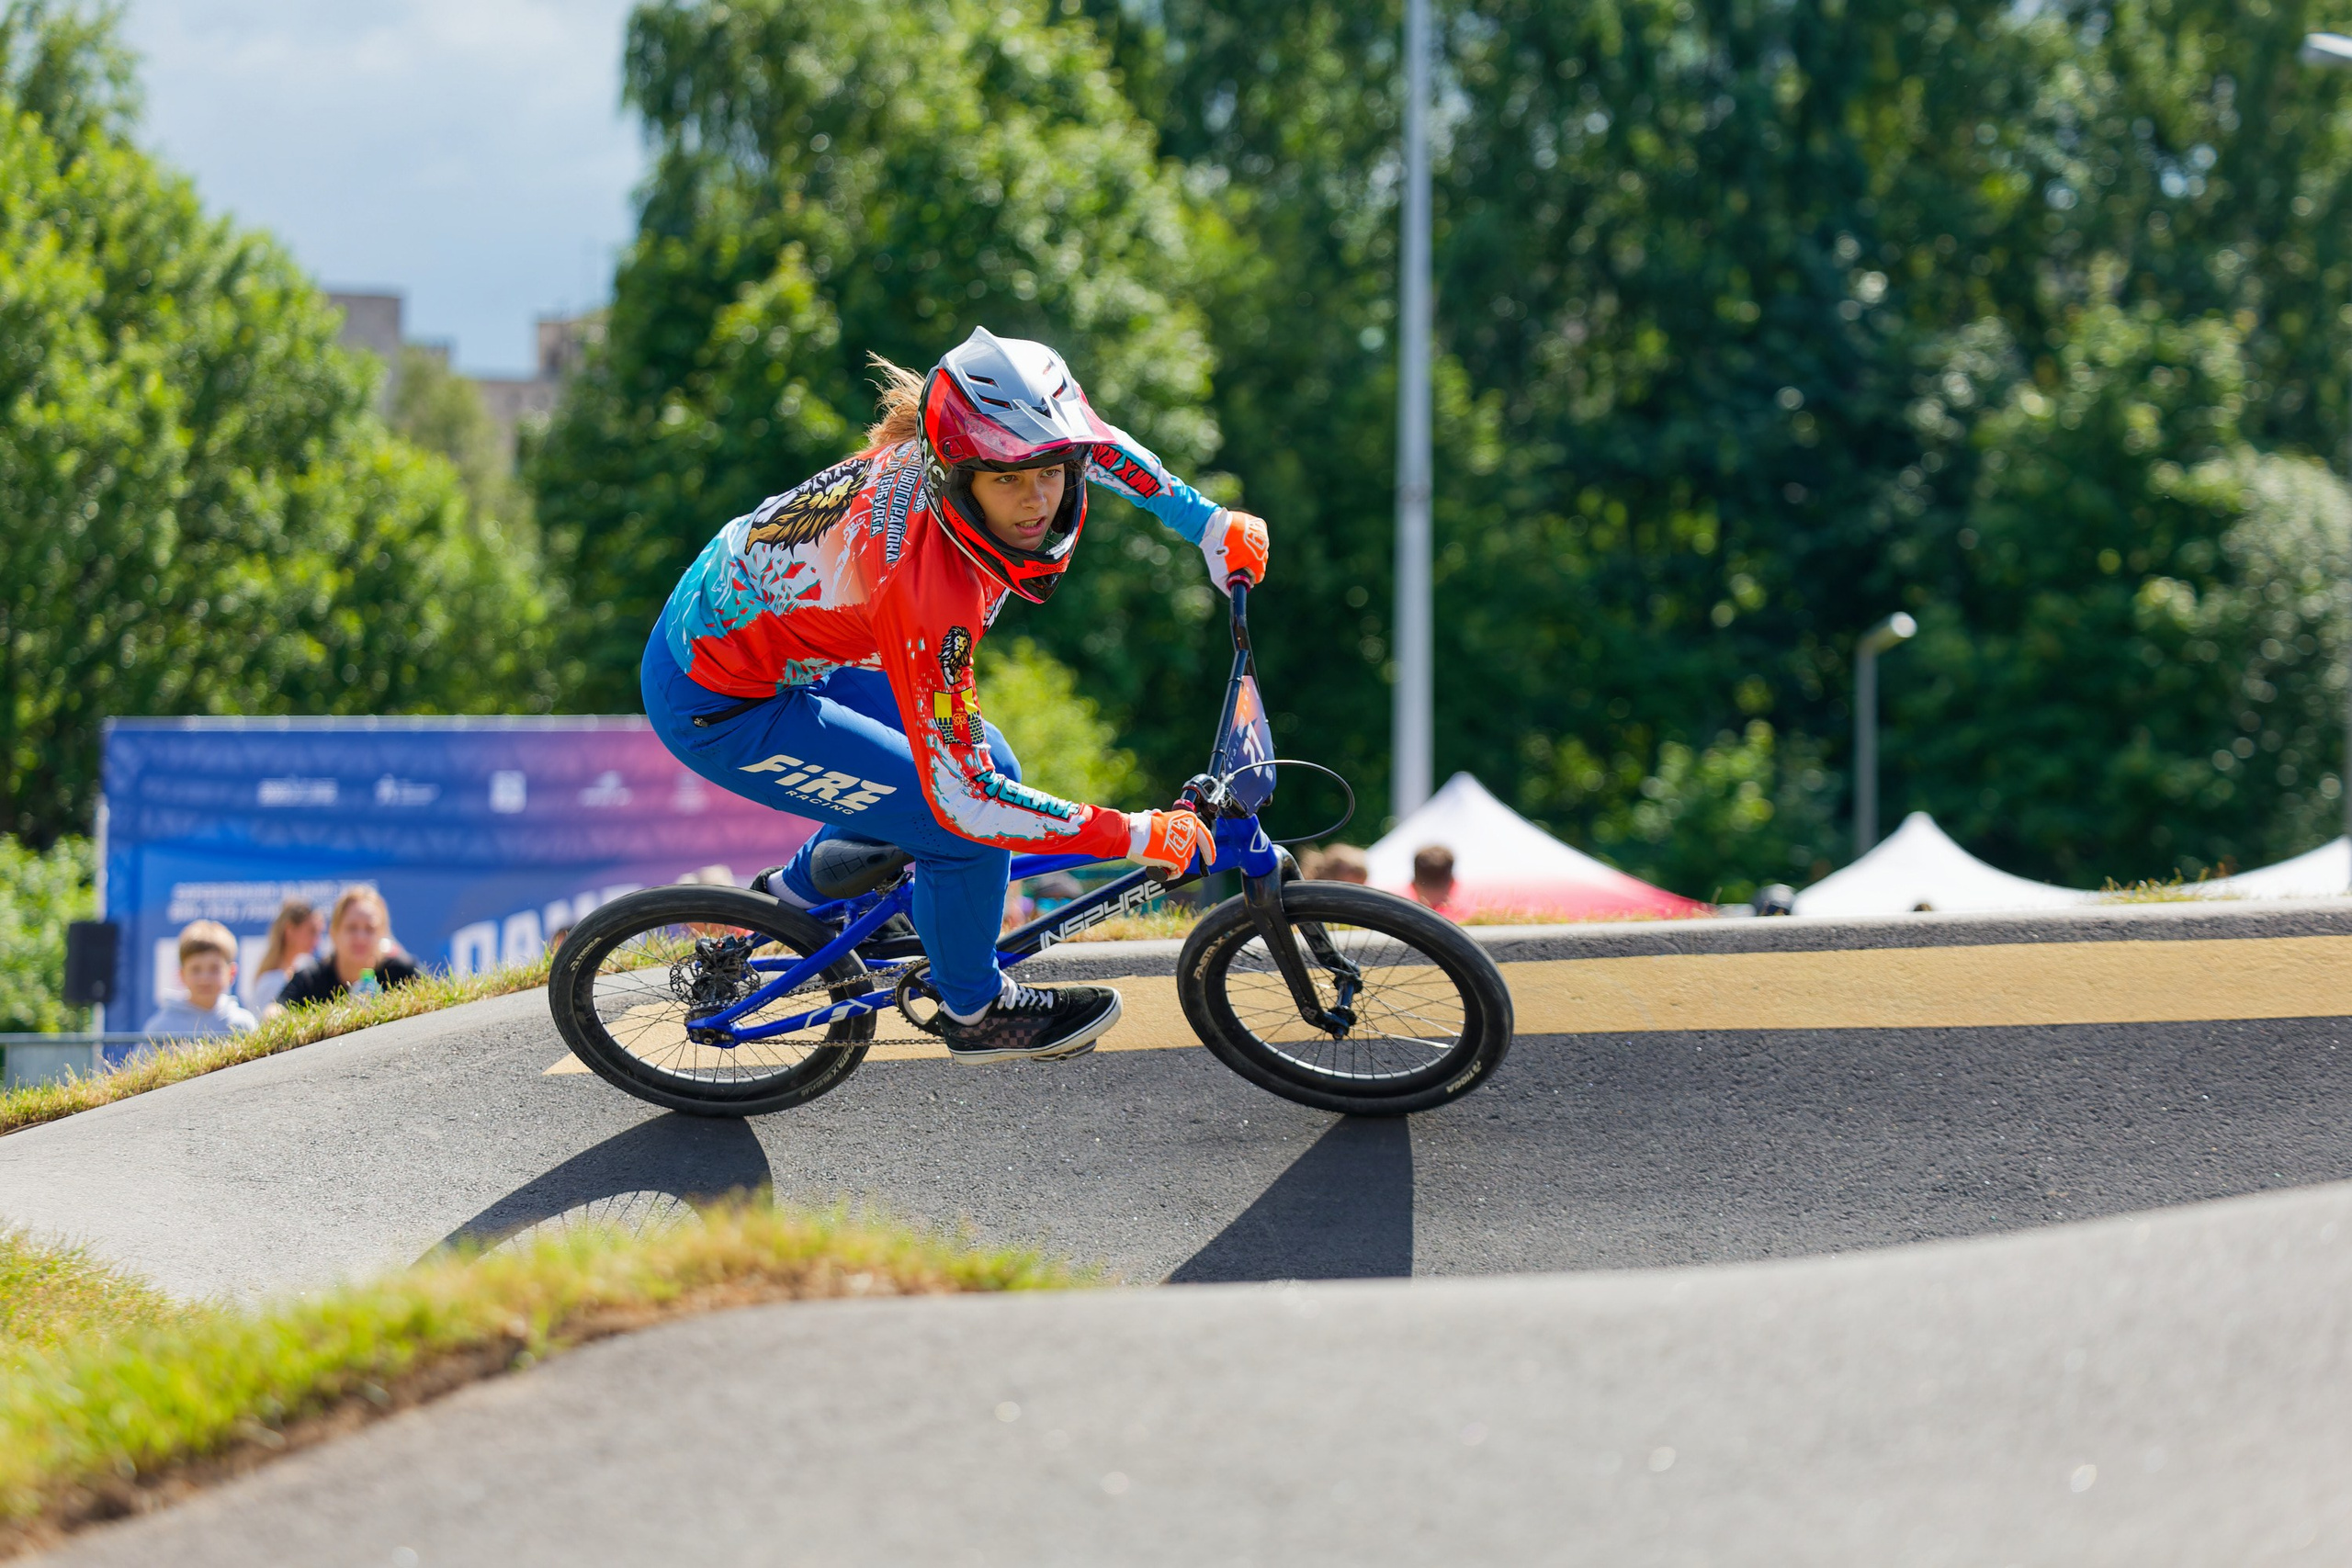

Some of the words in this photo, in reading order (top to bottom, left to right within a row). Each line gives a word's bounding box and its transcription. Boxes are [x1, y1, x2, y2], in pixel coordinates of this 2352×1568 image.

[886, 505, 909, 563] РАЙОНА
[785, 790, 854, 816] RACING
[1039, 879, 1166, 951] INSPYRE
[1445, 1069, 1476, 1093] TIOGA
